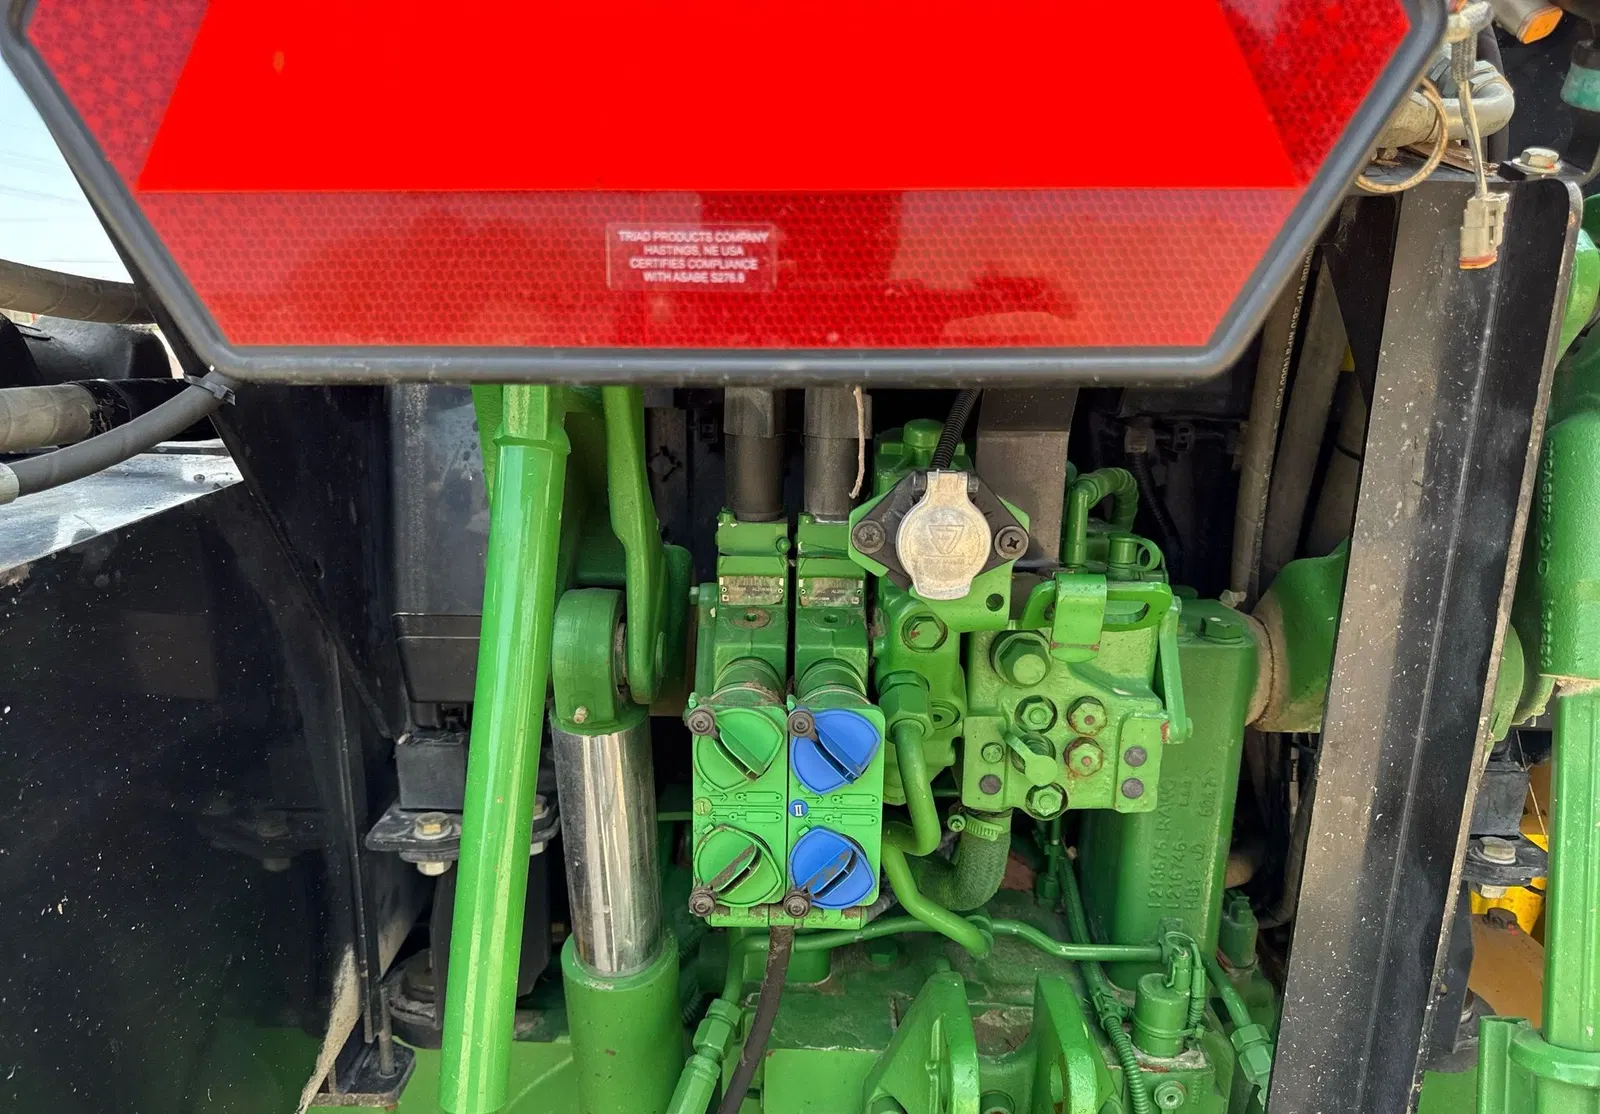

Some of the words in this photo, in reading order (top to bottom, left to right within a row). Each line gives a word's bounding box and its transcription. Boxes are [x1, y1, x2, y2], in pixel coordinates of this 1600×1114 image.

[653, 231, 712, 243] PRODUCTS
[714, 232, 770, 243] COMPANY
[644, 245, 702, 256] HASTINGS,
[704, 245, 720, 255] NE
[721, 245, 745, 256] USA
[629, 258, 686, 269] CERTIFIES
[687, 259, 758, 270] COMPLIANCE
[643, 272, 672, 282] WITH
